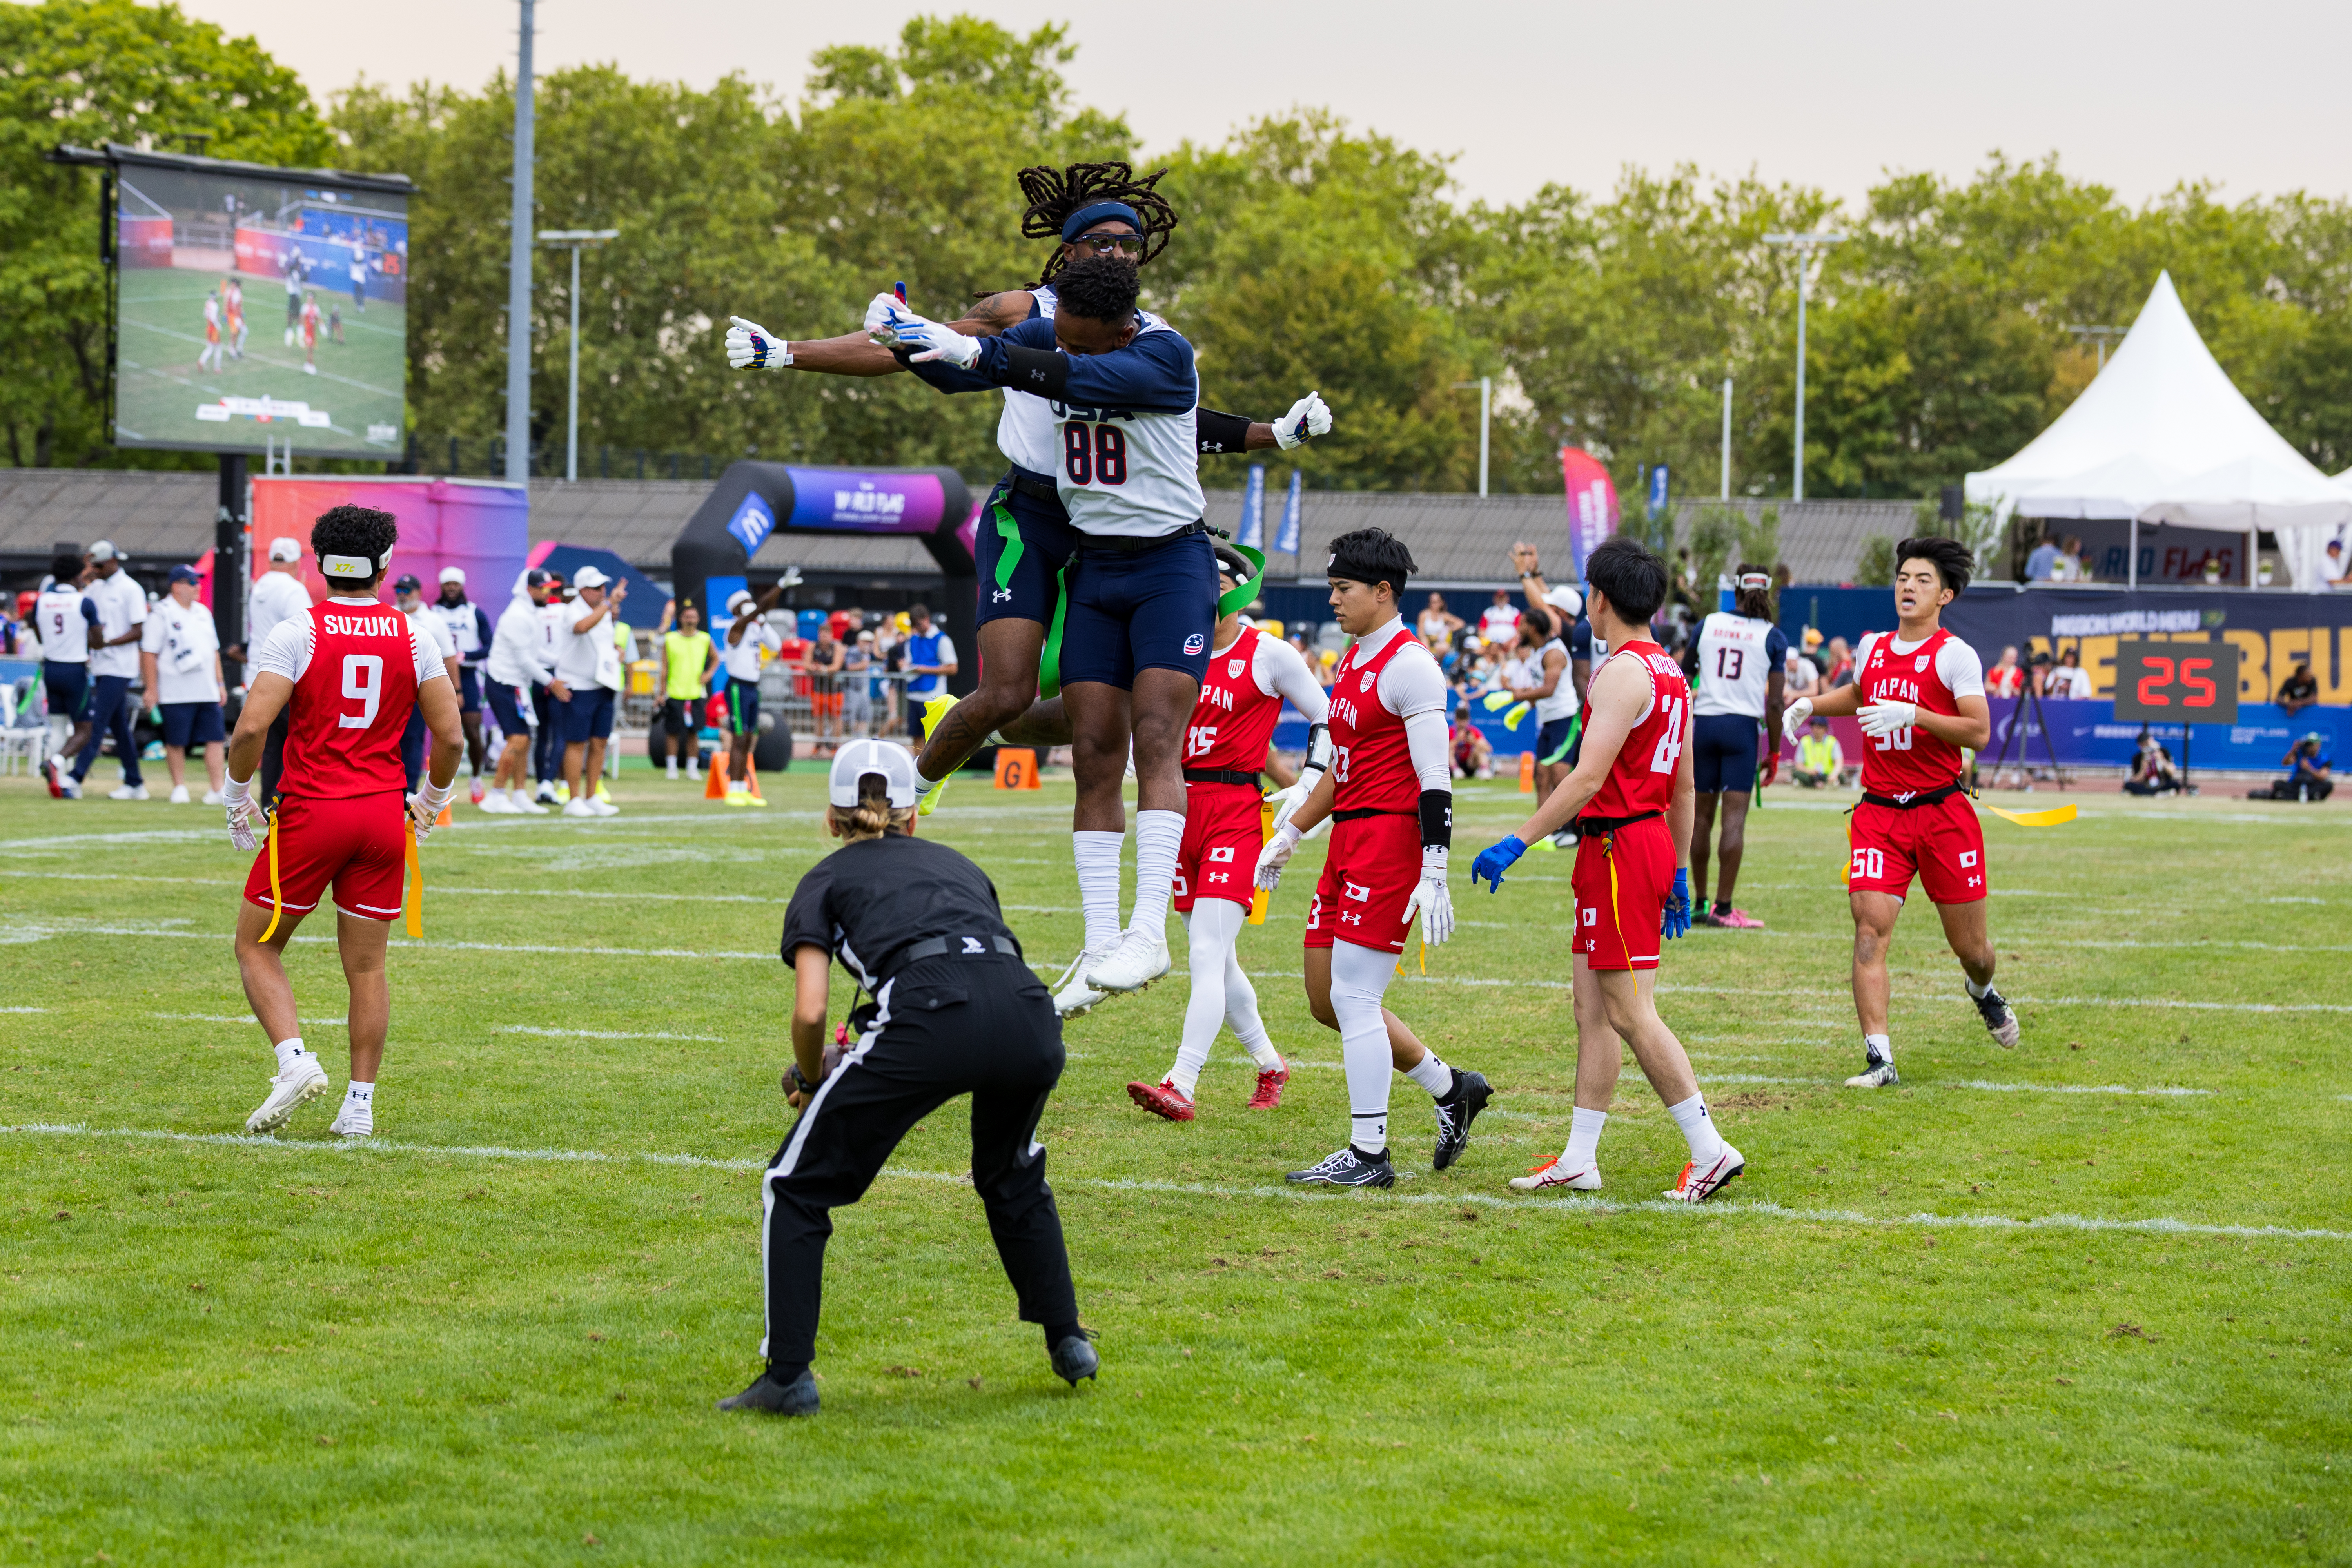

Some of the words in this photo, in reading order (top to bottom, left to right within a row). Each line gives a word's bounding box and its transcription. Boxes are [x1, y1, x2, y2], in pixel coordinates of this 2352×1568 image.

[1063, 421, 1127, 485] 88
[54, 613, 64, 634] 9
[324, 615, 398, 637] SUZUKI
[1714, 628, 1740, 639] BROWN
[1717, 647, 1744, 680] 13
[338, 654, 383, 729] 9
[1869, 678, 1919, 704] JAPAN
[2137, 657, 2216, 707] 25
[1200, 684, 1234, 712] PAN
[1188, 726, 1218, 757] 15
[1650, 694, 1682, 775] 24
[1004, 761, 1021, 788] G
[1851, 847, 1884, 880] 50
